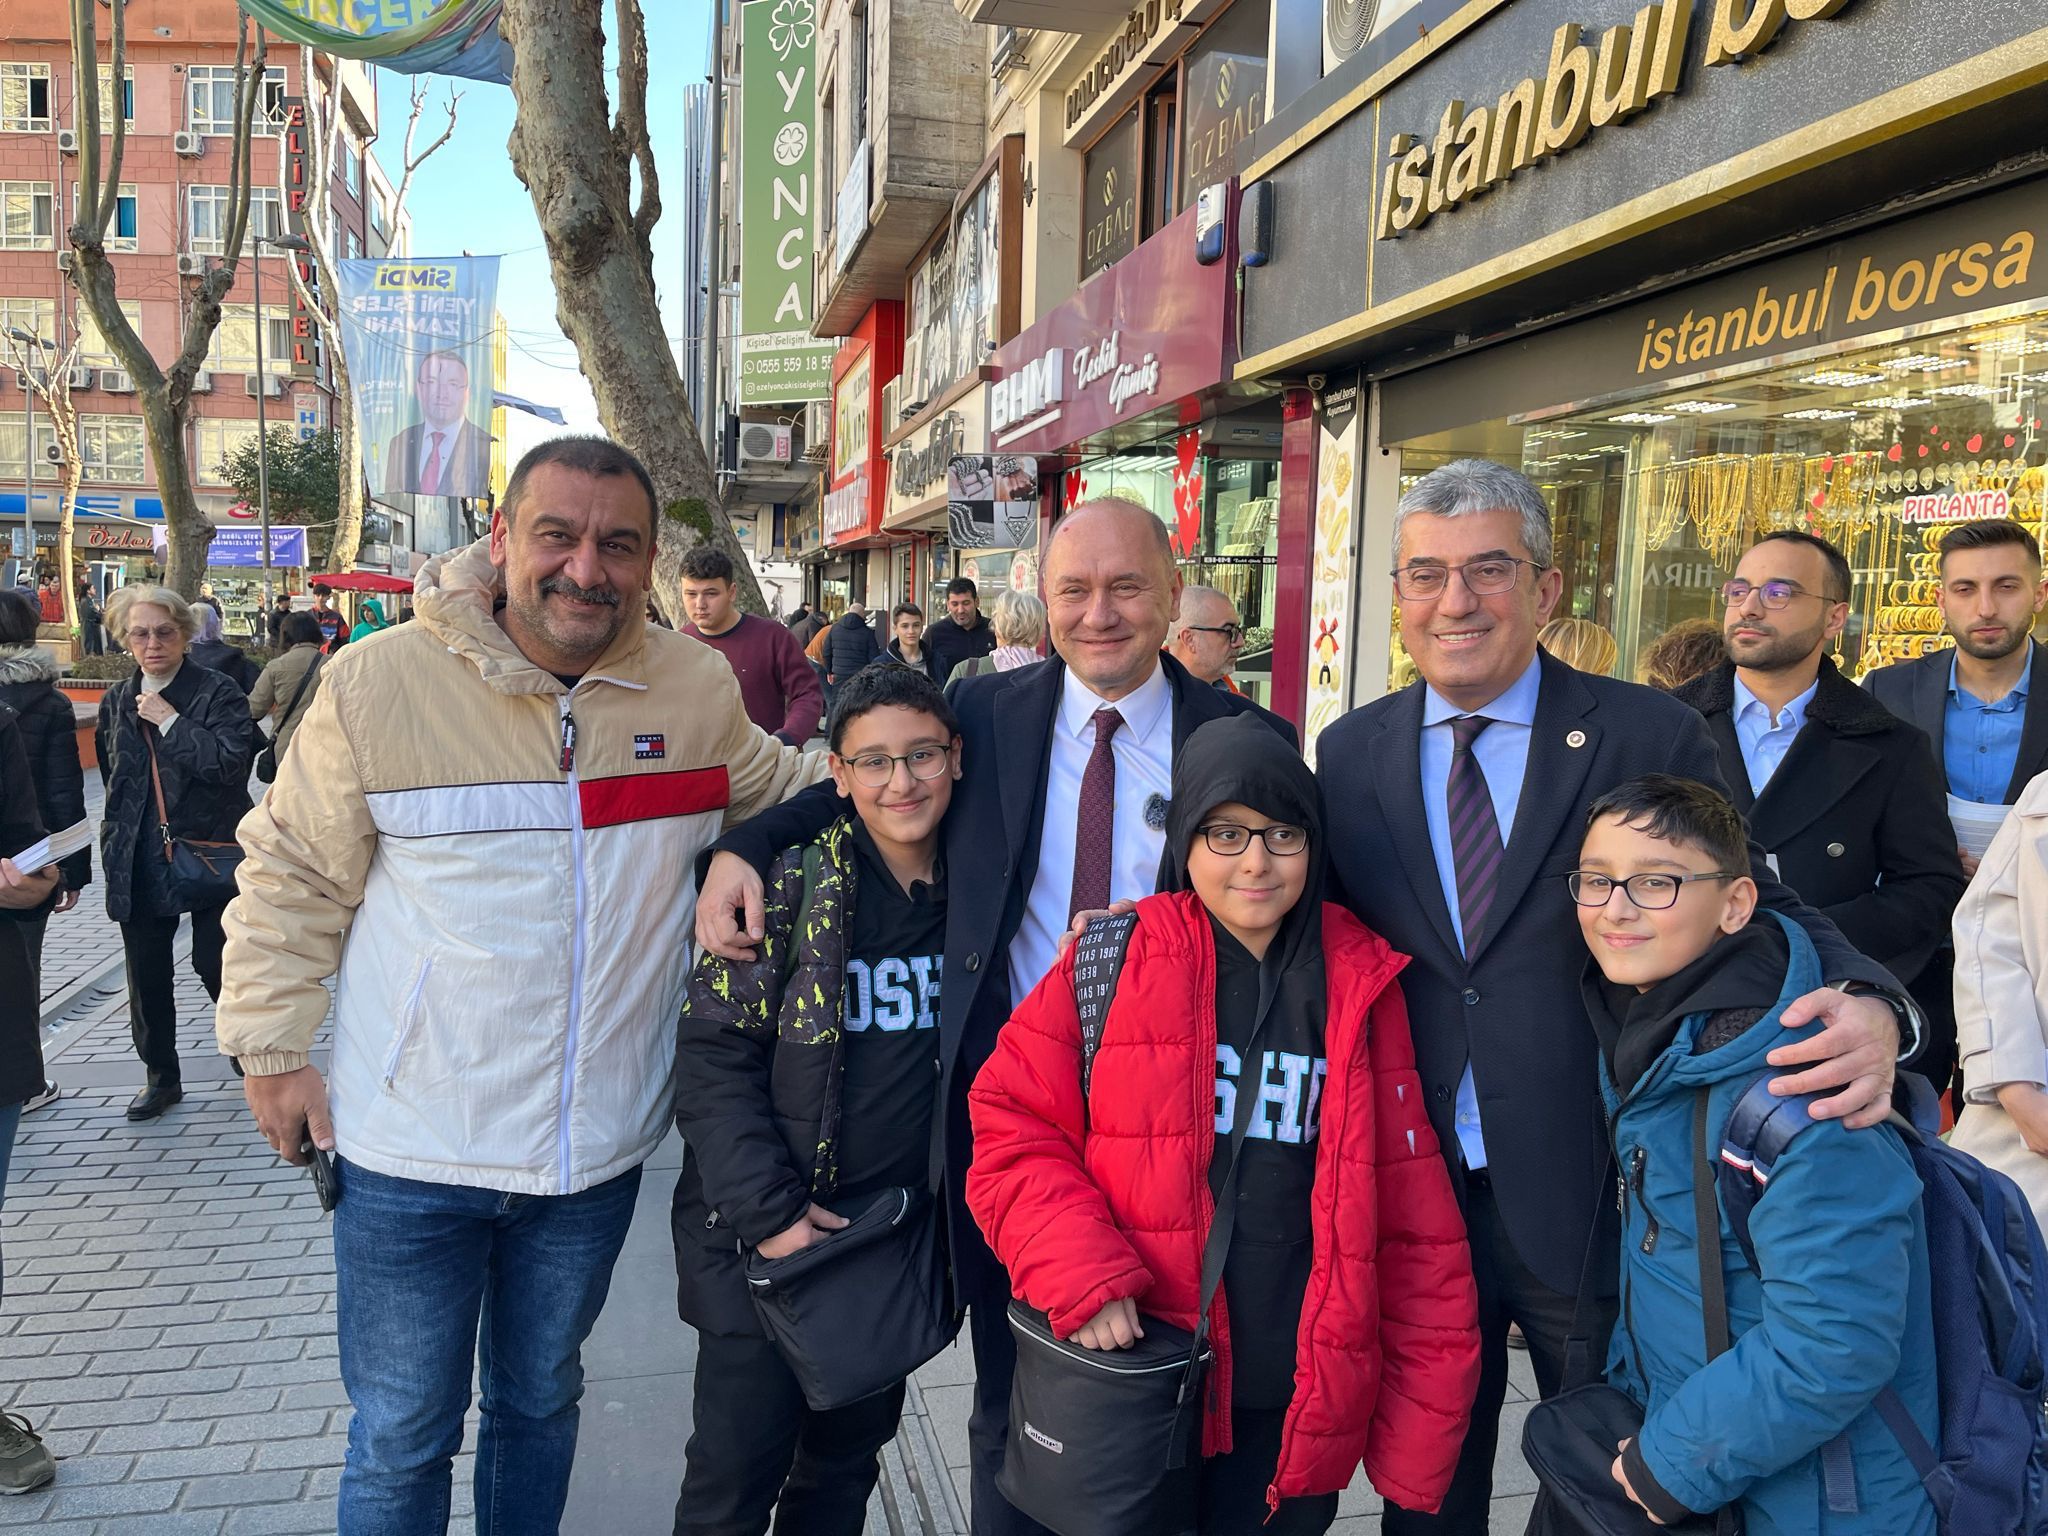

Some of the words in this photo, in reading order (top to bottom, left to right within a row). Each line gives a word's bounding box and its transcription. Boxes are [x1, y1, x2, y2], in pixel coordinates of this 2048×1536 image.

[1066, 0, 1161, 129] HALICIOĞLU
[287, 105, 306, 213] ELİF
[1377, 0, 1692, 240] istanbul
[746, 336, 772, 349] Kişisel
[775, 335, 805, 346] Gelişim
[1637, 266, 1837, 374] istanbul
[1846, 230, 2034, 324] borsa
[756, 358, 780, 373] 0555
[783, 357, 801, 372] 559
[806, 356, 817, 371] 18
[991, 348, 1063, 433] BHM
[1109, 353, 1159, 414] Gümüş
[1904, 492, 2008, 521] PIRLANTA
